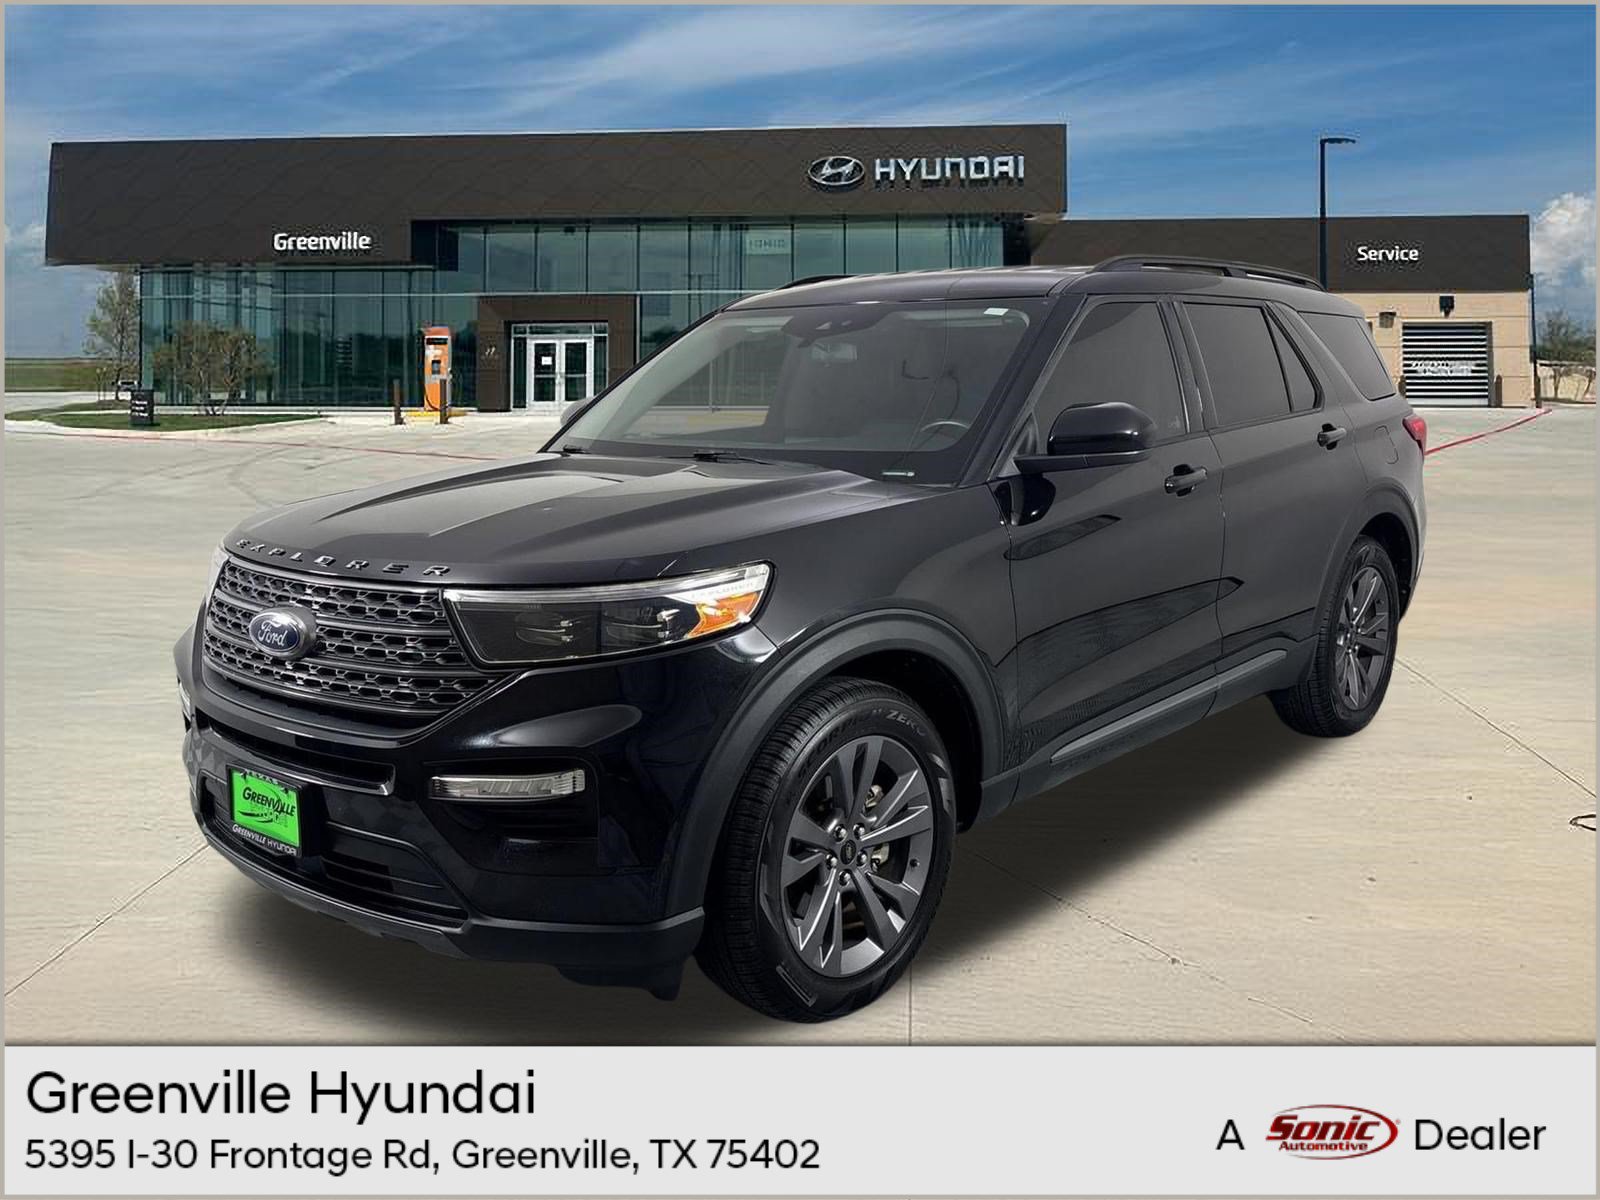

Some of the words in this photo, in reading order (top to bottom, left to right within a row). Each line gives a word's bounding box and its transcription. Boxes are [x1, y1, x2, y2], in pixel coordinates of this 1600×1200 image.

[875, 155, 1025, 181] HYUNDAI
[273, 231, 371, 251] Greenville
[1356, 244, 1420, 262] Service
[236, 539, 452, 577] EXPLORER
[257, 620, 288, 648] Ford
[242, 786, 296, 817] GREENVILLE
[232, 824, 267, 844] GREENVILLE
[267, 838, 297, 856] HYUNDAI
